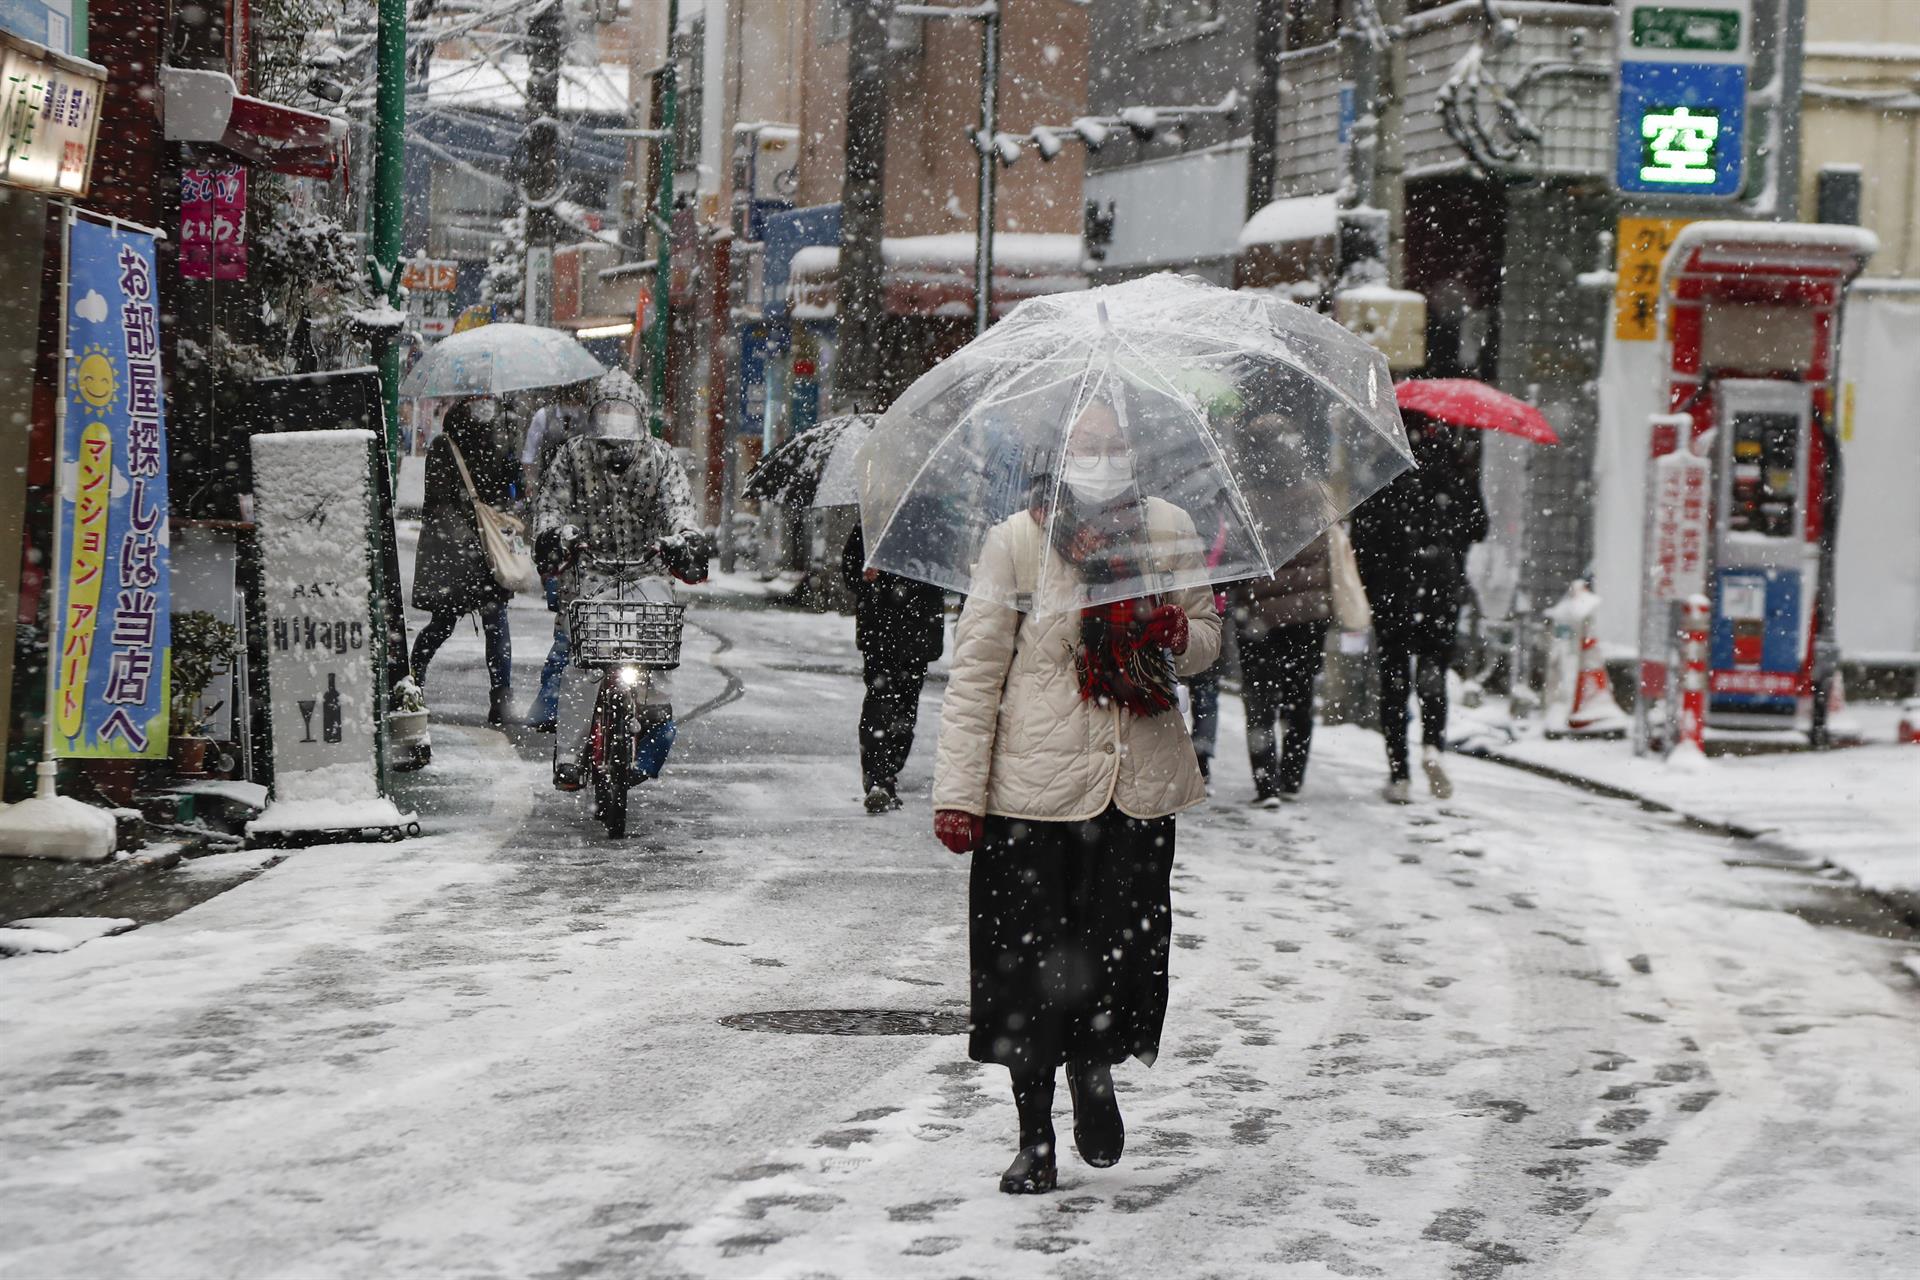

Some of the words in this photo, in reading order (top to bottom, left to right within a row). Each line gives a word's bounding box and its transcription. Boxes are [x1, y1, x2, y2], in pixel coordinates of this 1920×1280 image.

[1640, 106, 1719, 184] 空
[75, 439, 107, 585] マンション
[99, 243, 160, 751] お部屋探しは当店へ
[64, 603, 94, 718] アパート
